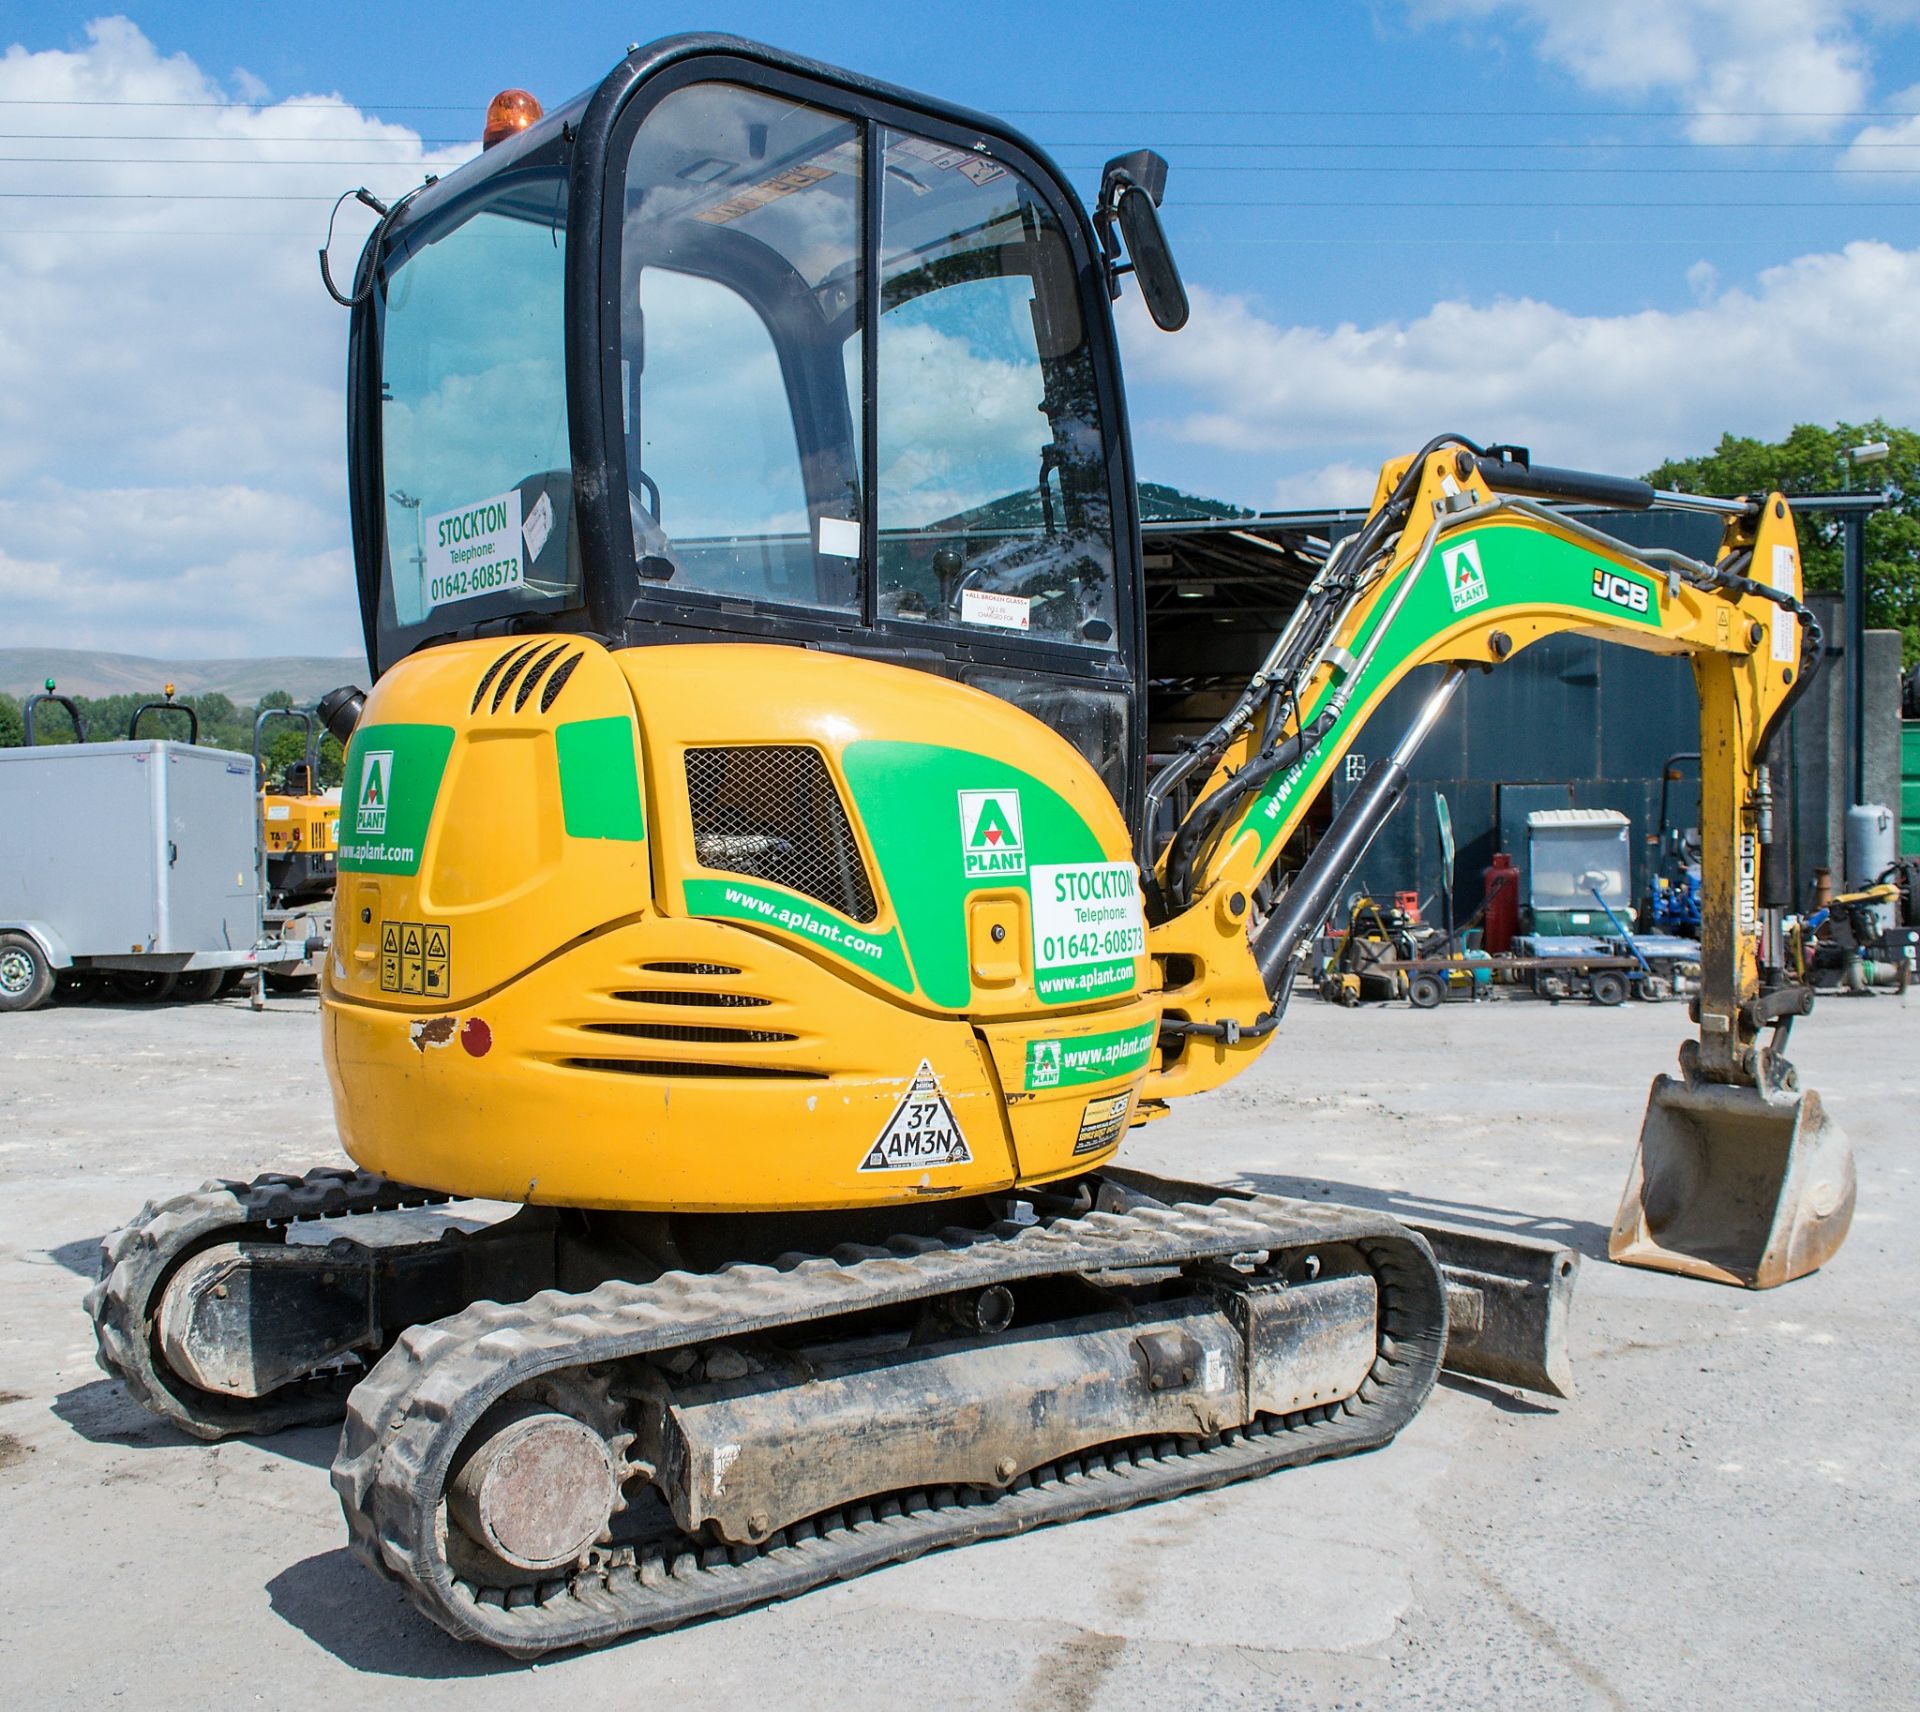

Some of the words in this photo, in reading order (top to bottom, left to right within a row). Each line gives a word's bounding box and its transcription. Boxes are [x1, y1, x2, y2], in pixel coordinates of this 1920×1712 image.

[438, 501, 507, 547] STOCKTON
[450, 542, 496, 564] Telephone:
[431, 558, 519, 601] 01642-608573
[1454, 551, 1480, 590] A
[981, 594, 1005, 602] BROKEN
[1005, 597, 1024, 605] GLASS
[1453, 583, 1486, 607] PLANT
[1593, 570, 1649, 613] JCB
[362, 759, 385, 805] A
[357, 812, 386, 829] PLANT
[970, 799, 1019, 847] A
[966, 853, 1024, 872] PLANT
[1055, 870, 1134, 902] STOCKTON
[725, 888, 883, 959] www.aplant.com
[1075, 907, 1128, 926] Telephone:
[1043, 927, 1144, 961] 01642-608573
[1039, 965, 1134, 994] www.aplant.com
[1064, 1033, 1153, 1068] www.aplant.com
[1033, 1073, 1058, 1085] PLANT
[907, 1103, 938, 1130] 37
[888, 1129, 953, 1158] AM3N
